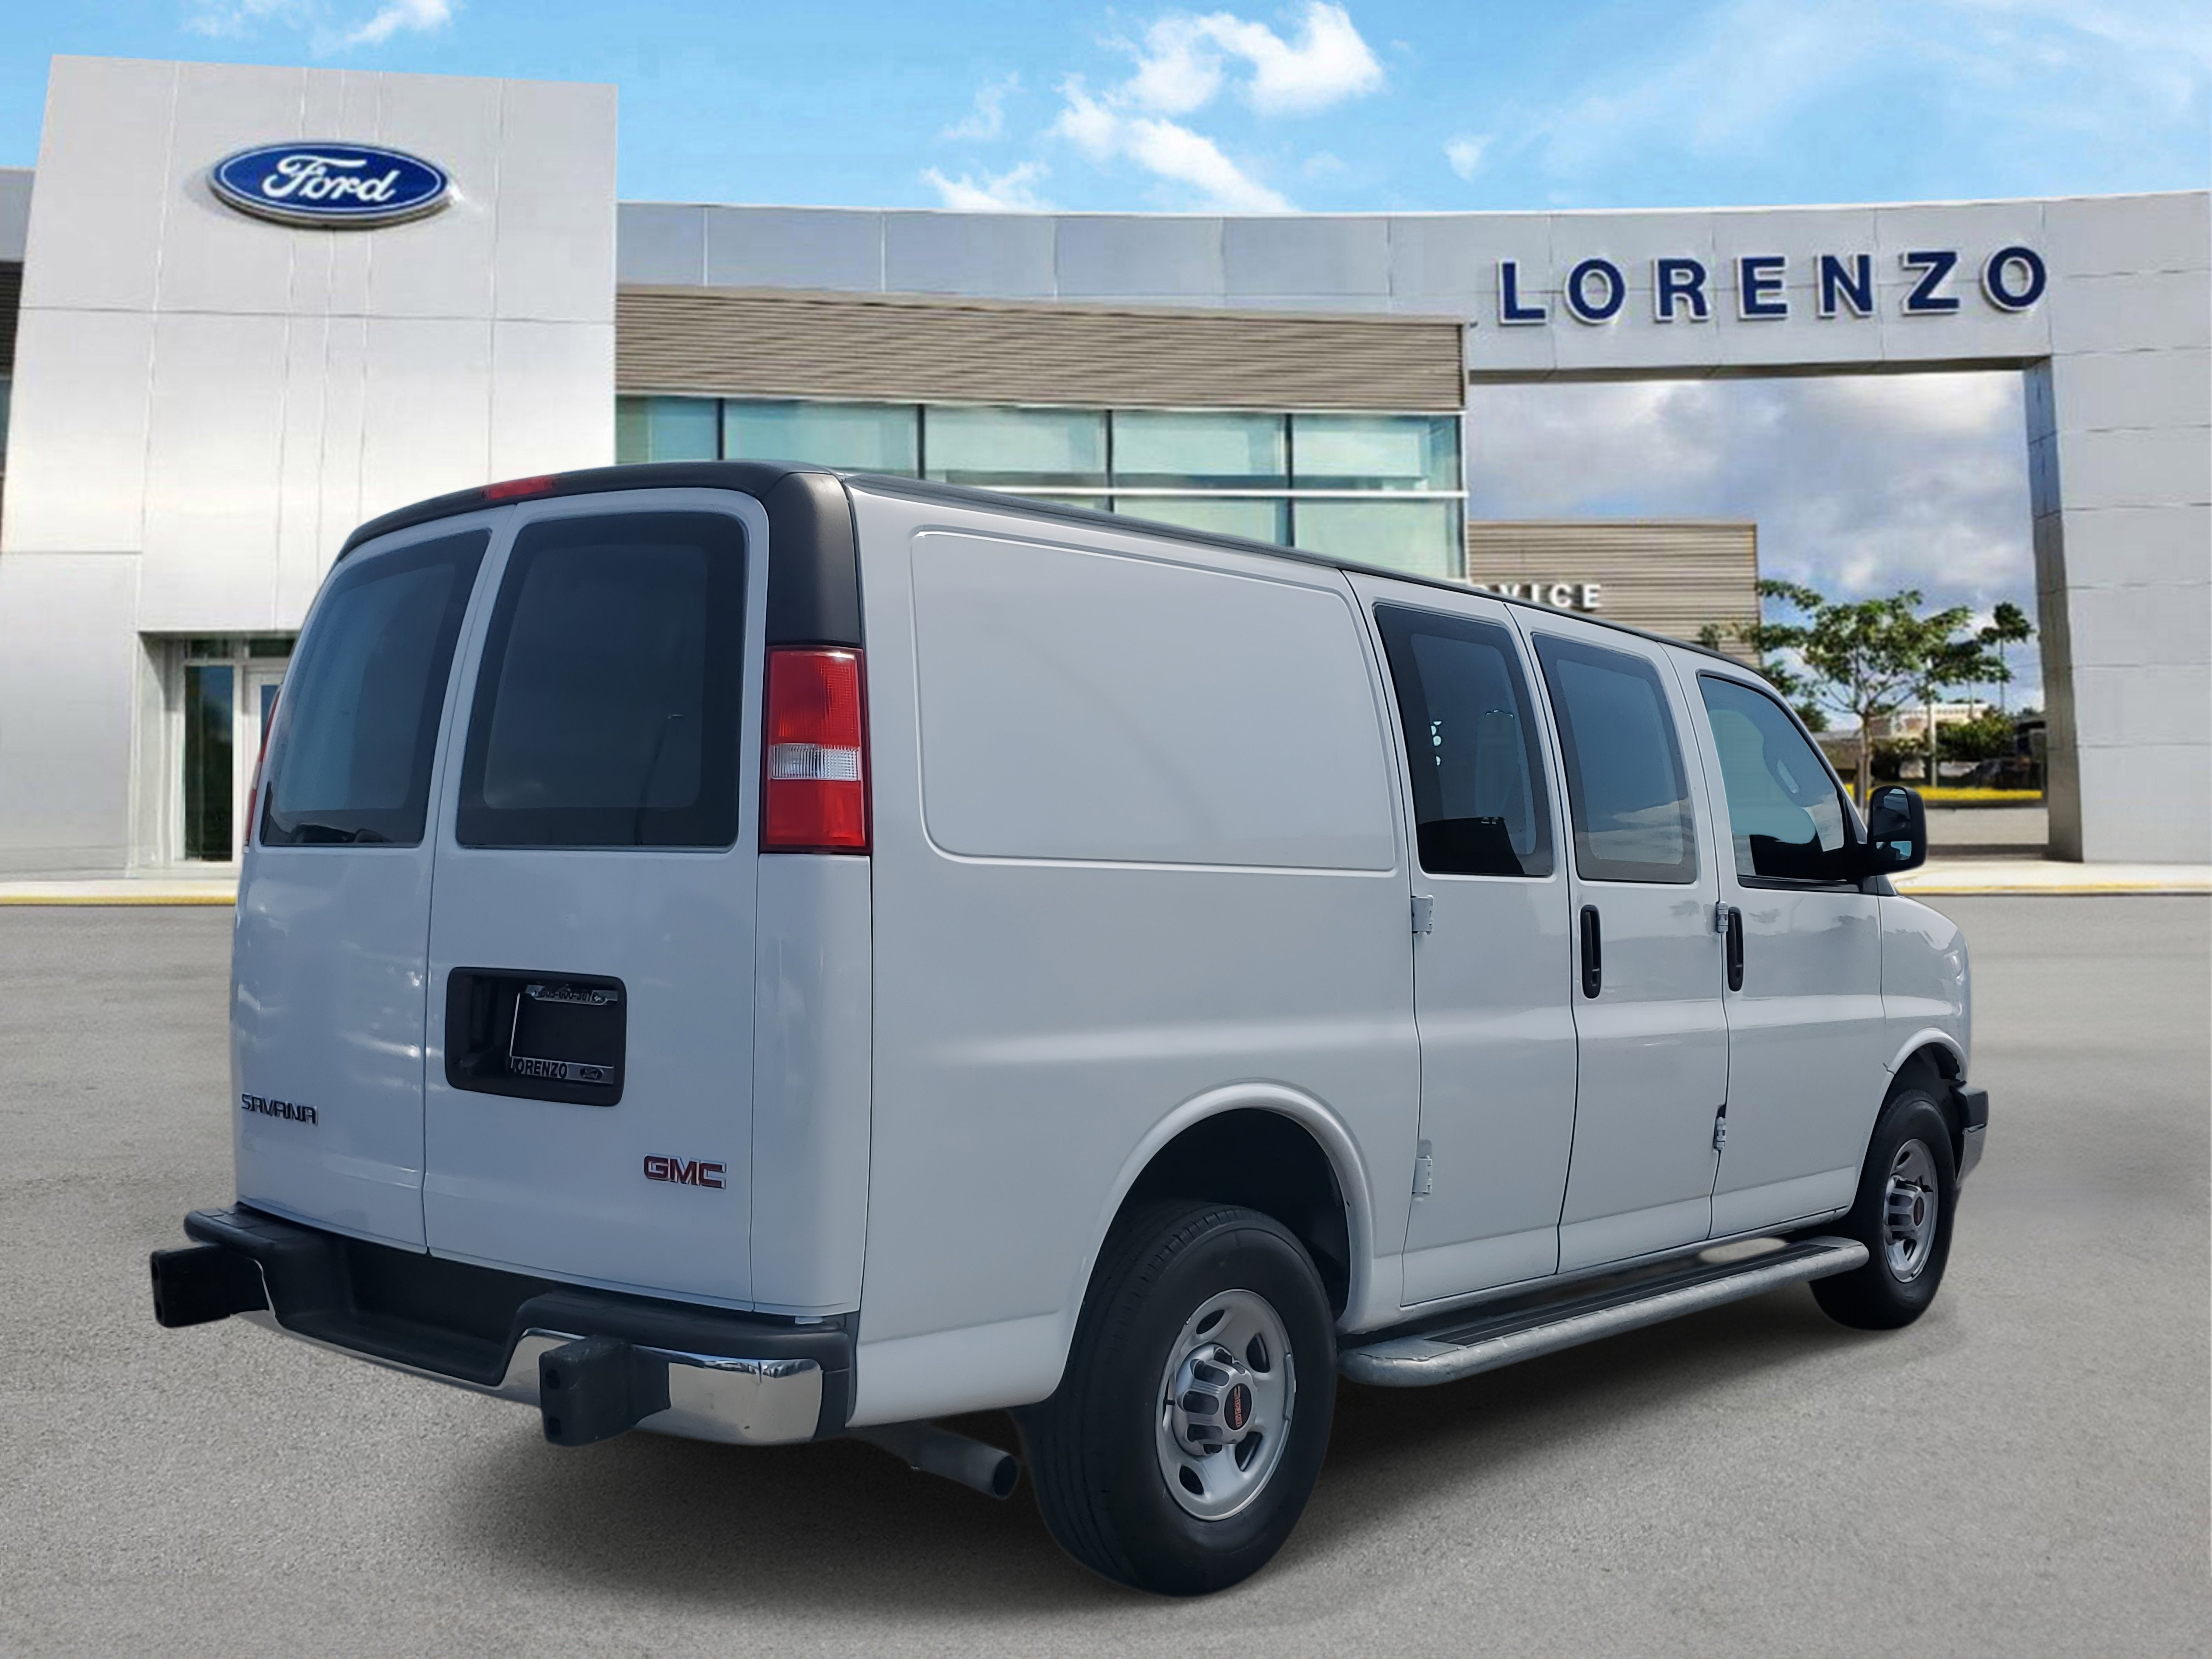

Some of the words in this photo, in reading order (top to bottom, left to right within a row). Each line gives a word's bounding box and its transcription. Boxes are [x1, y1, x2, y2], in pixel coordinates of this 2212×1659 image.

[262, 154, 400, 202] Ford
[1498, 247, 2047, 324] LORENZO
[241, 1092, 319, 1126] SAVANA
[644, 1153, 727, 1189] GMC
[1234, 1385, 1242, 1427] GMC
